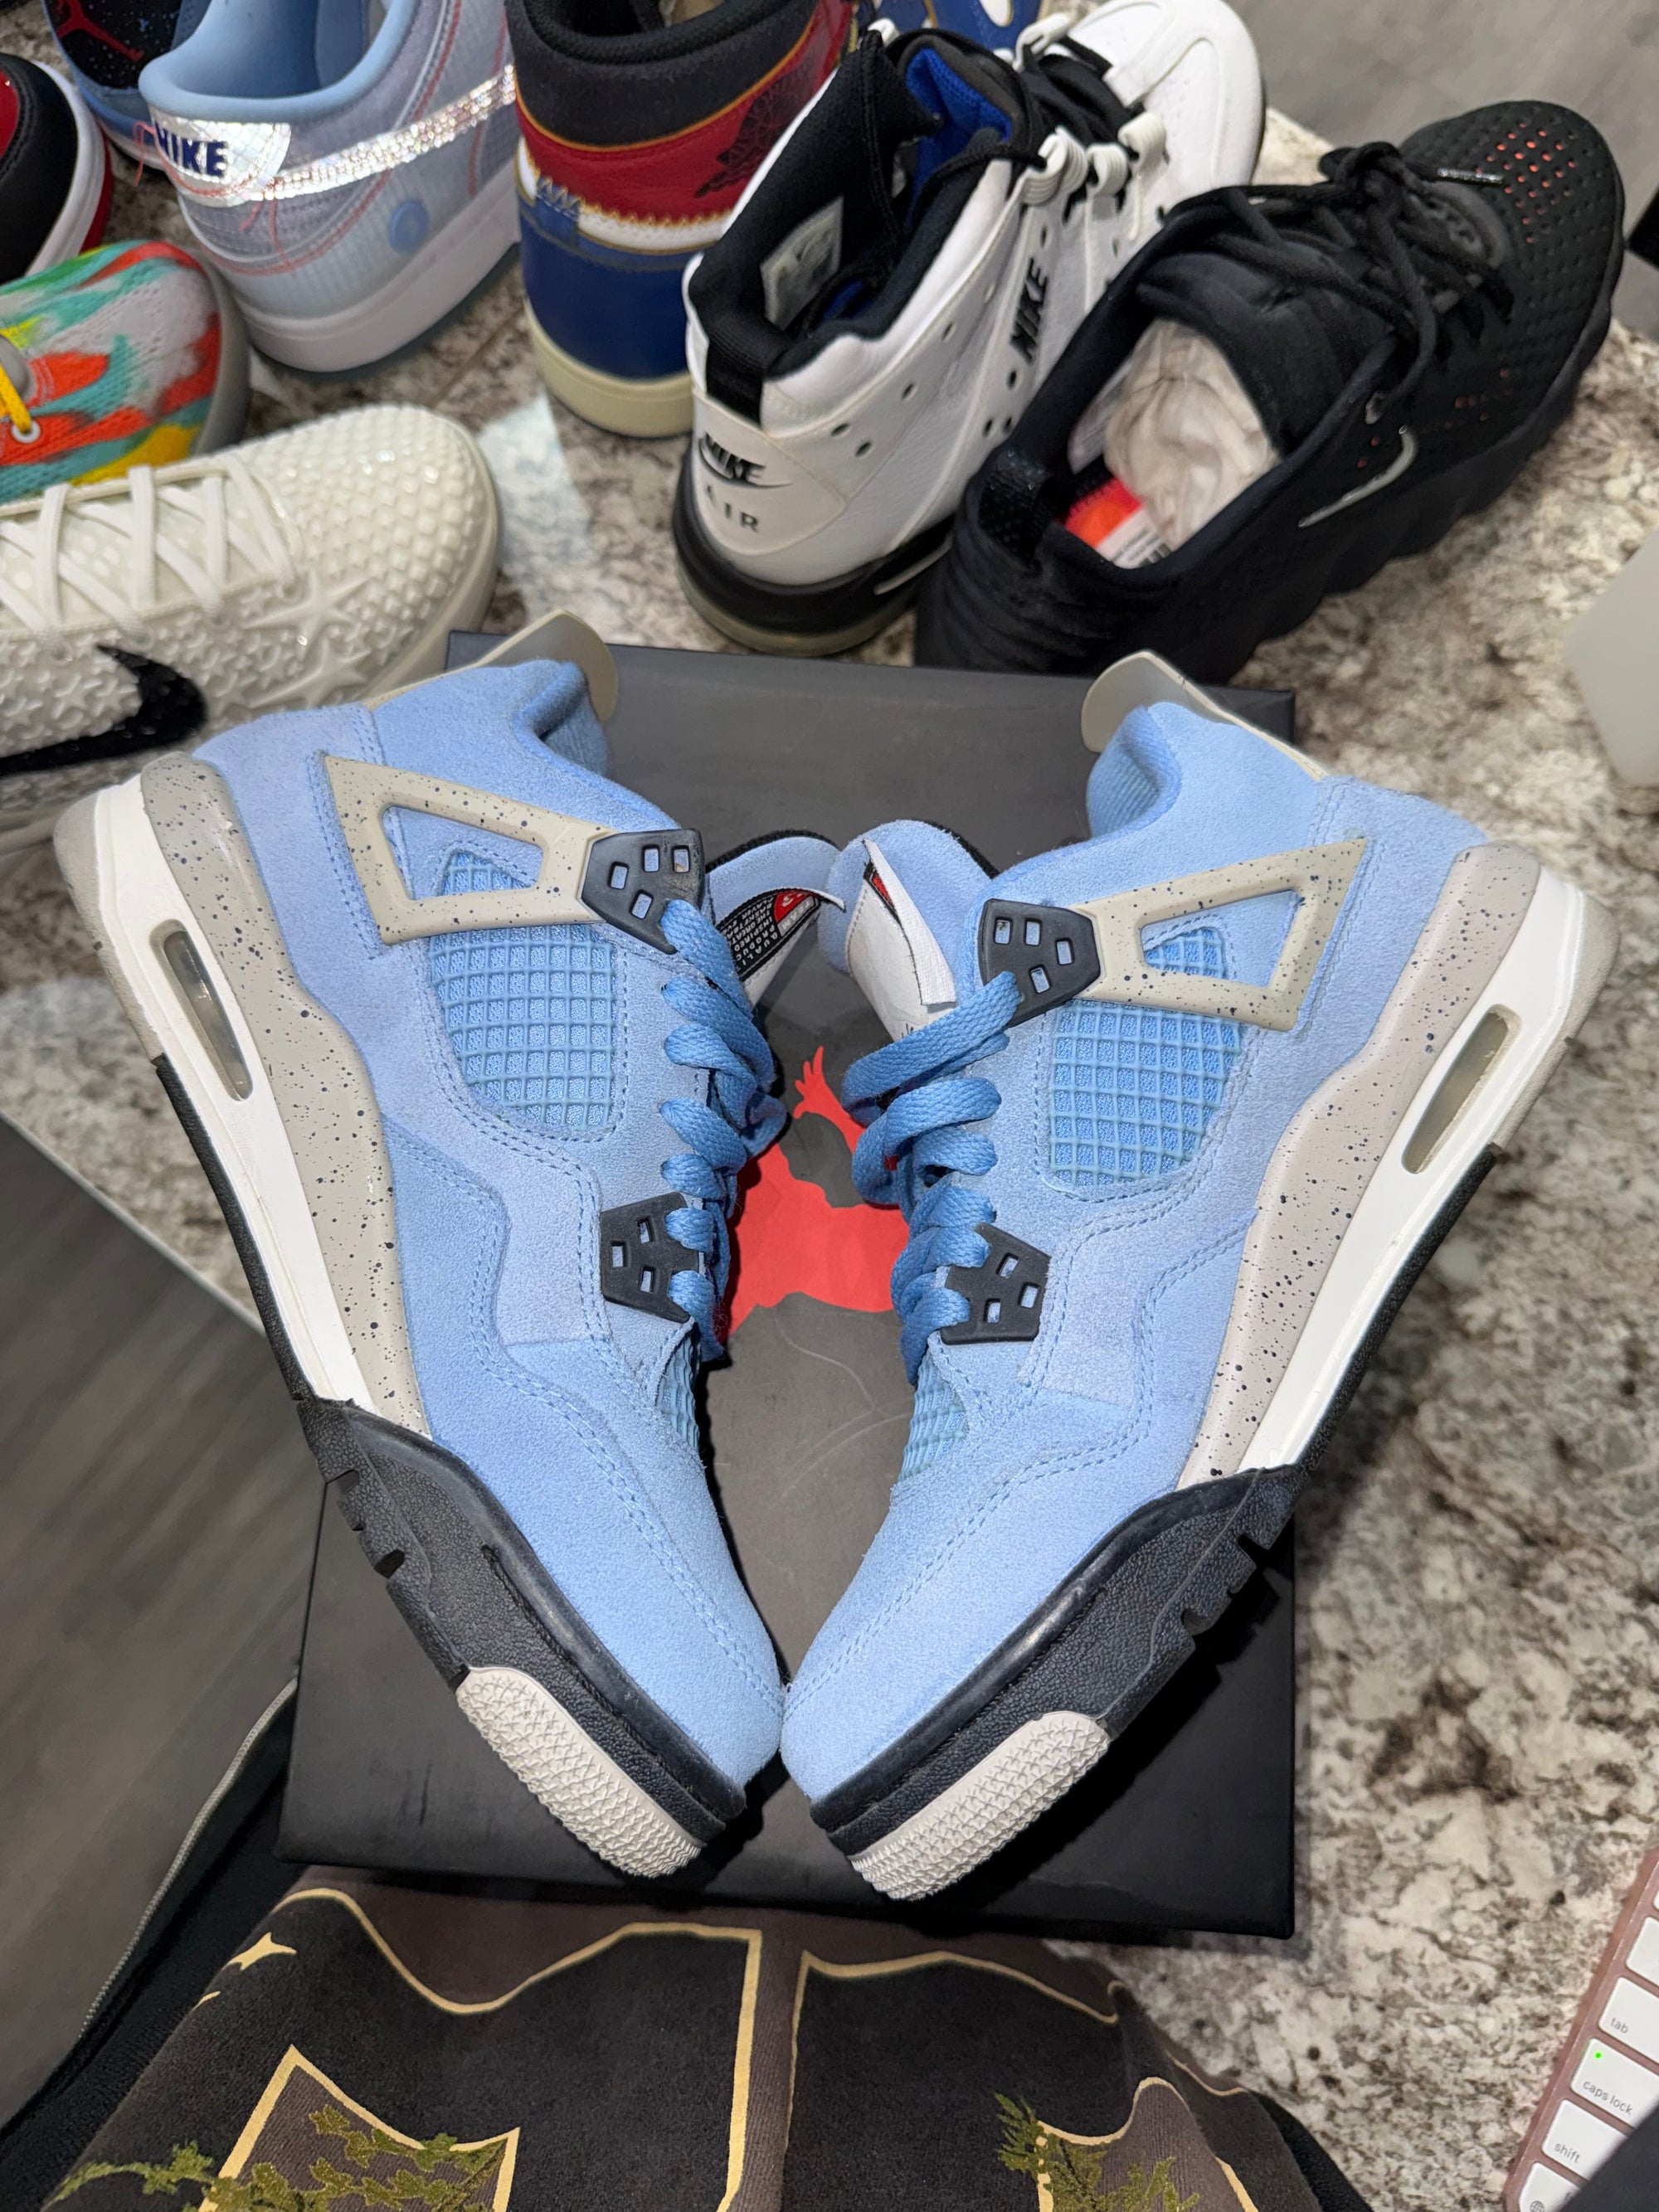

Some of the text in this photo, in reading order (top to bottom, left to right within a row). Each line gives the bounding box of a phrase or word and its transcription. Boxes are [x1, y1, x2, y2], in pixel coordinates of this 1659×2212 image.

[154, 121, 228, 177] NIKE
[1010, 257, 1048, 363] NIKE
[704, 430, 766, 484] NIKE
[722, 920, 738, 936] EVE
[727, 902, 773, 940] BASKETBA
[781, 900, 812, 930] TEAM
[730, 922, 757, 946] GREAT
[733, 916, 773, 952] INSPIRED
[734, 924, 776, 962] PRODUC
[737, 932, 778, 972] QUALIT
[1610, 2017, 1629, 2035] tab
[1583, 2080, 1633, 2116] caps lock
[1554, 2143, 1580, 2164] shift
